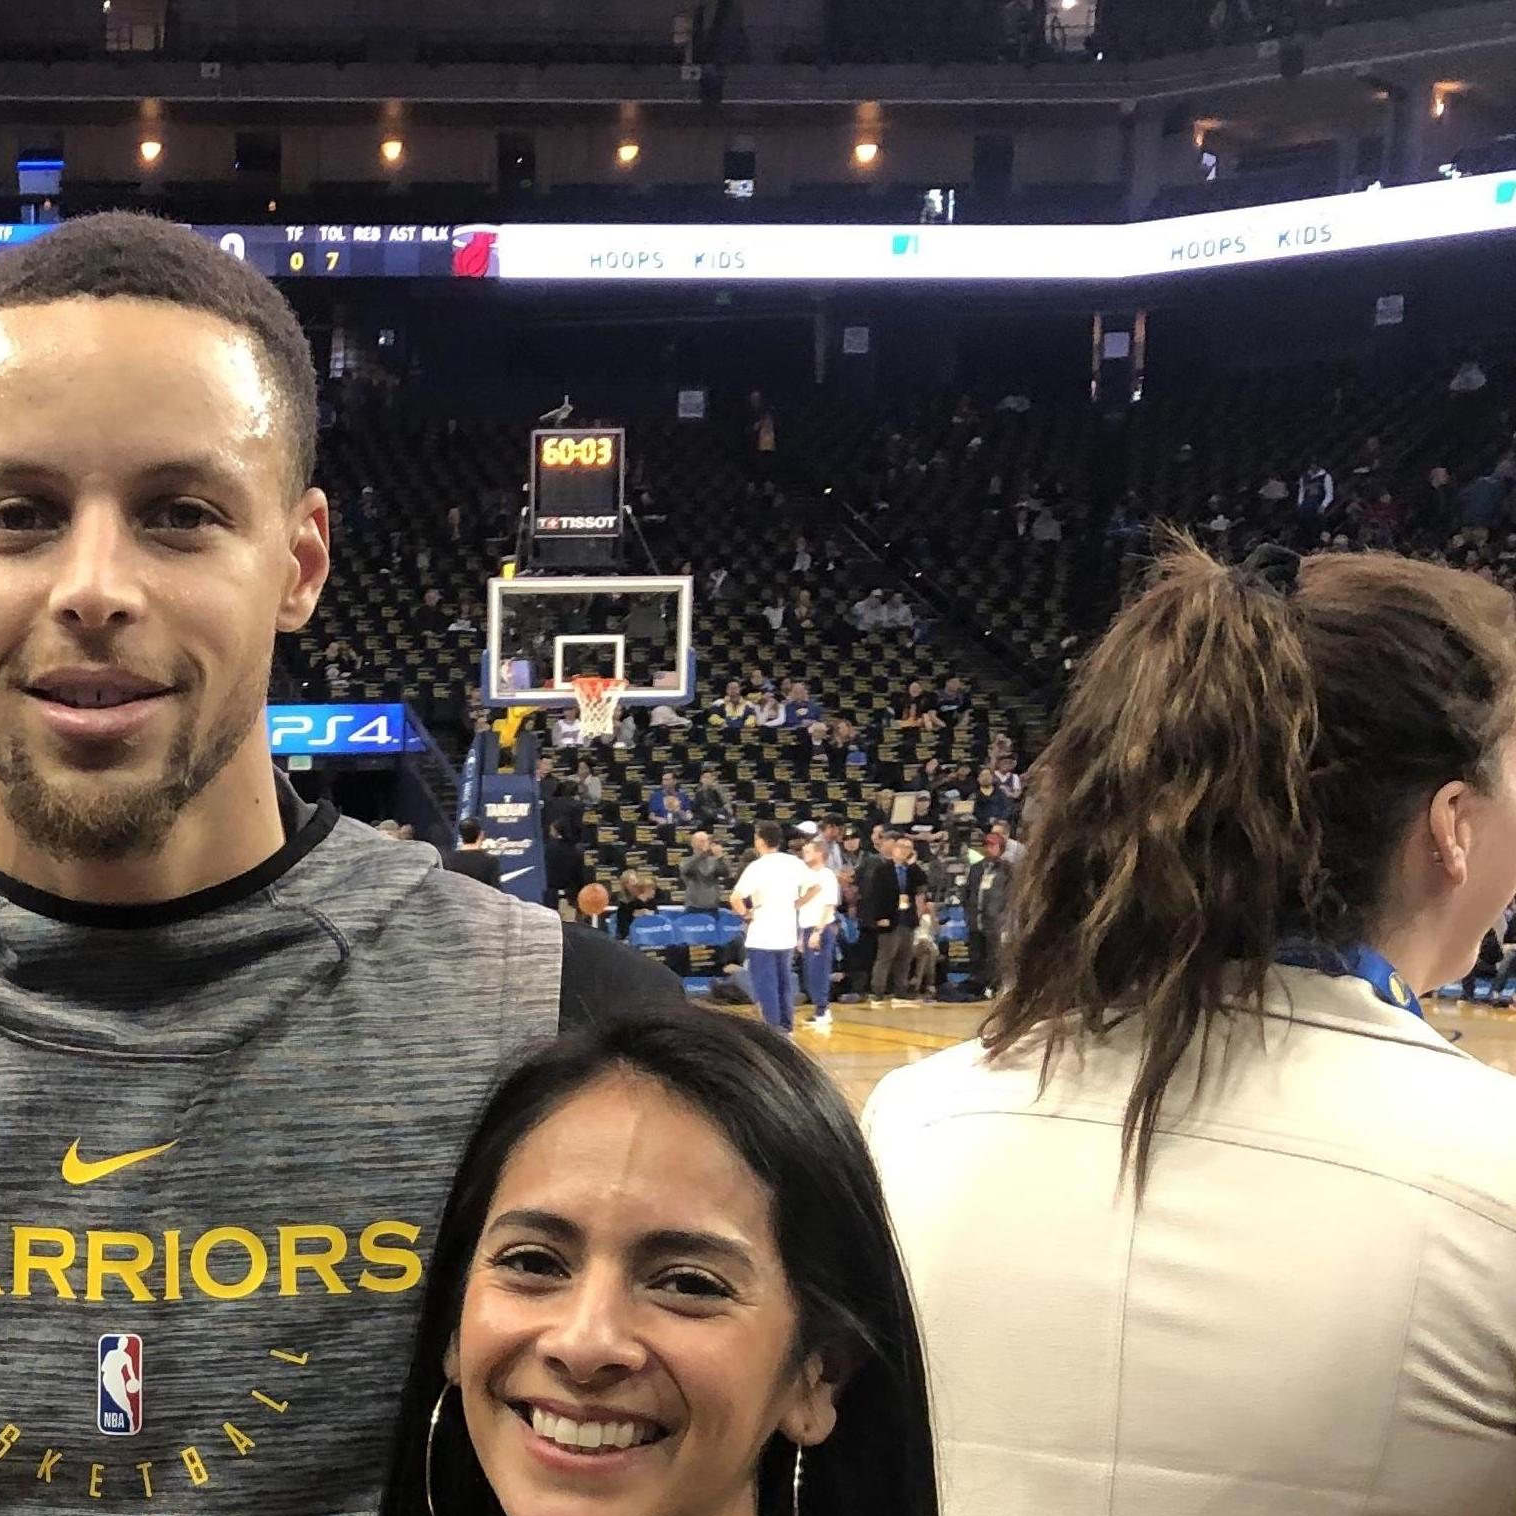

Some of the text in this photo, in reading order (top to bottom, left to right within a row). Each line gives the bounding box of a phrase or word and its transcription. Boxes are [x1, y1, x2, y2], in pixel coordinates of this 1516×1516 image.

[285, 226, 304, 242] TF
[319, 226, 346, 242] TOL
[353, 226, 382, 242] REB
[389, 226, 416, 242] AST
[1171, 224, 1332, 260] HOOPS KIDS
[289, 251, 340, 271] 0 7
[590, 251, 745, 269] HOOPS KIDS
[542, 437, 612, 465] 60:03
[559, 515, 618, 529] TISSOT
[271, 715, 393, 746] PS4
[104, 1411, 125, 1428] NBA
